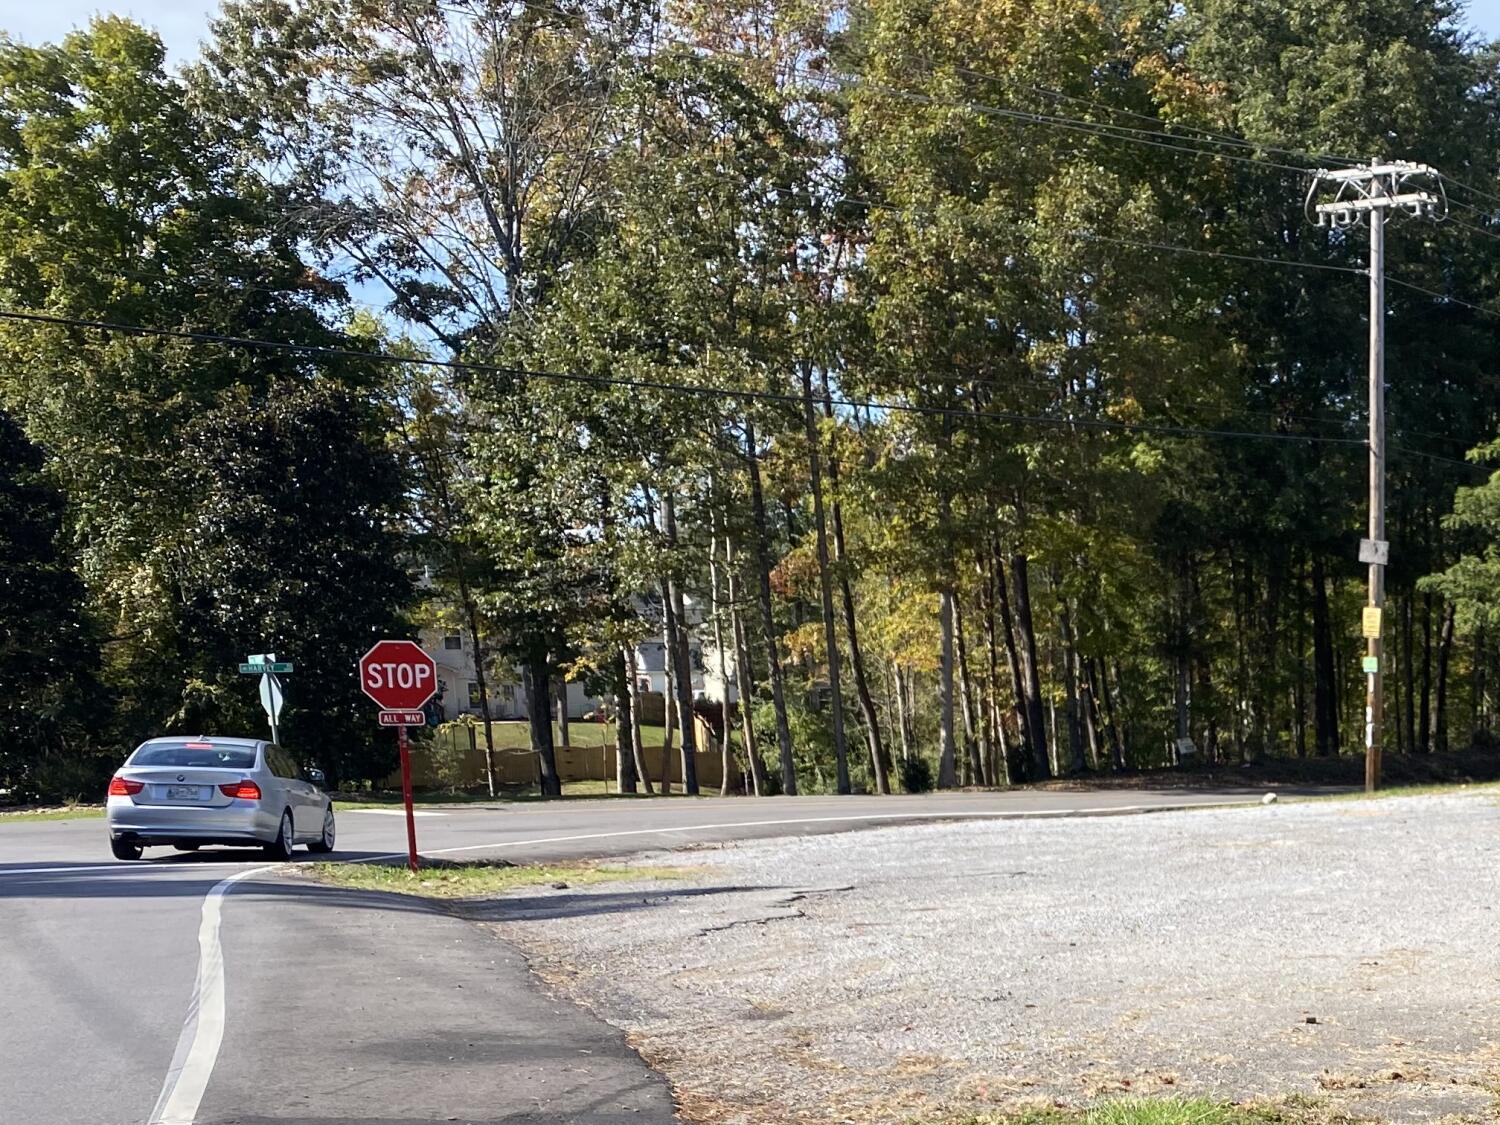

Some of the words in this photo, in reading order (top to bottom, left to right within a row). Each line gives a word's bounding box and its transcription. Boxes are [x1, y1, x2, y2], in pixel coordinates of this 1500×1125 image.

[367, 663, 431, 689] STOP
[383, 714, 400, 723] ALL
[404, 714, 421, 723] WAY
